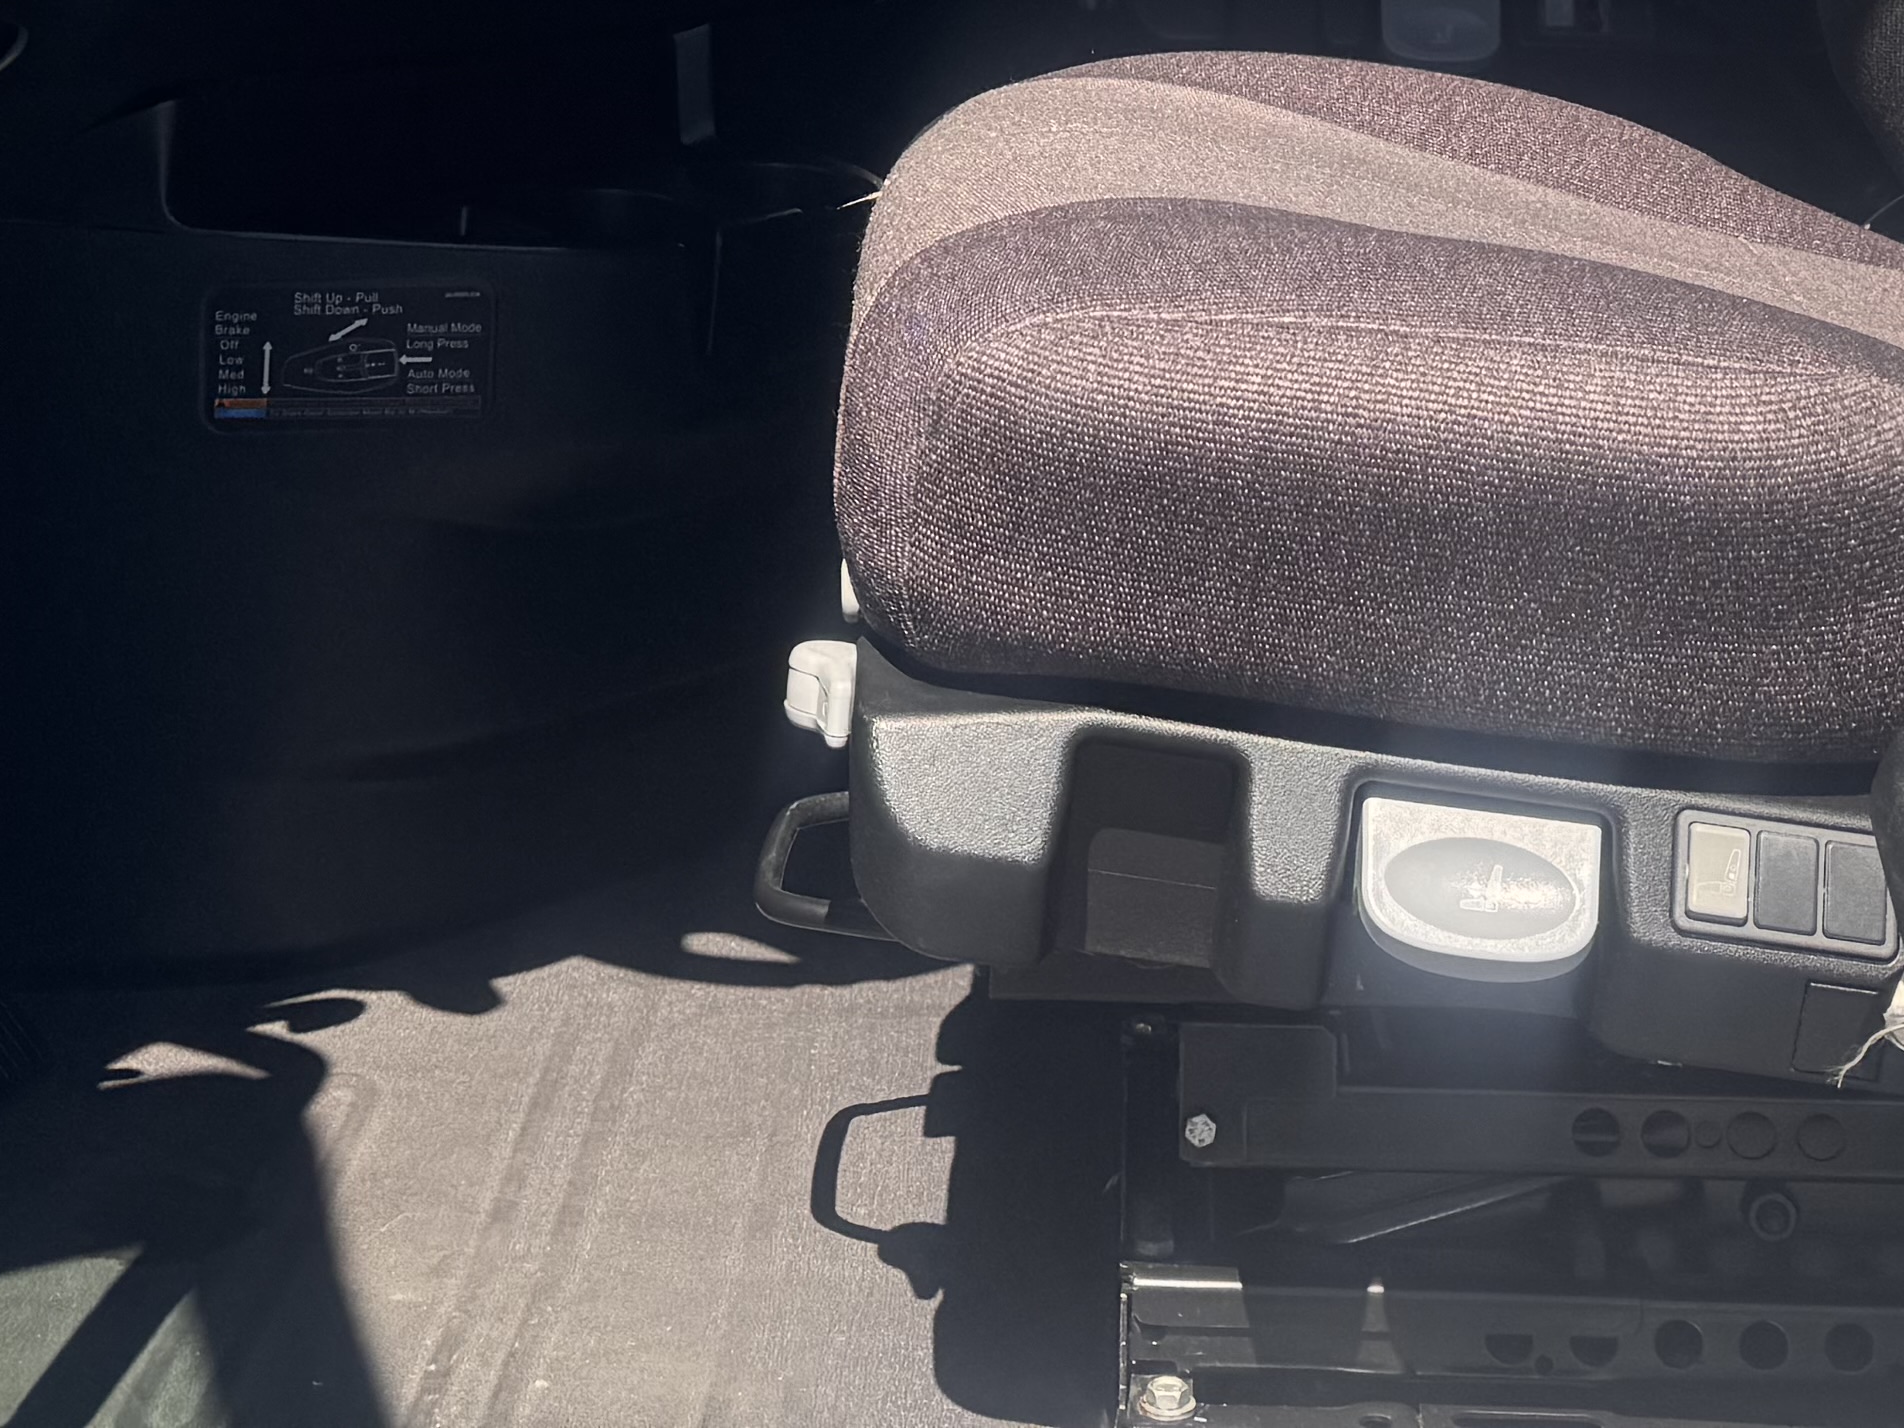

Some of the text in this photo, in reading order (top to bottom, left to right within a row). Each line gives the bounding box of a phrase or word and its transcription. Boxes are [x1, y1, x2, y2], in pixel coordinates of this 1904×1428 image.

[294, 291, 322, 304] Shift
[326, 292, 343, 305] Up
[355, 291, 379, 303] Pull
[294, 304, 321, 315] Shift
[325, 304, 360, 315] Down
[372, 304, 403, 315] Push
[215, 310, 257, 323] Engine
[215, 324, 250, 335] Brake
[406, 322, 482, 333] Manual Mode
[220, 339, 239, 350] Off
[406, 337, 469, 351] Long Press
[219, 354, 244, 365] Low
[218, 369, 244, 380] Med
[407, 368, 470, 379] Auto Mode
[218, 383, 246, 396] High
[406, 382, 476, 394] Short Press
